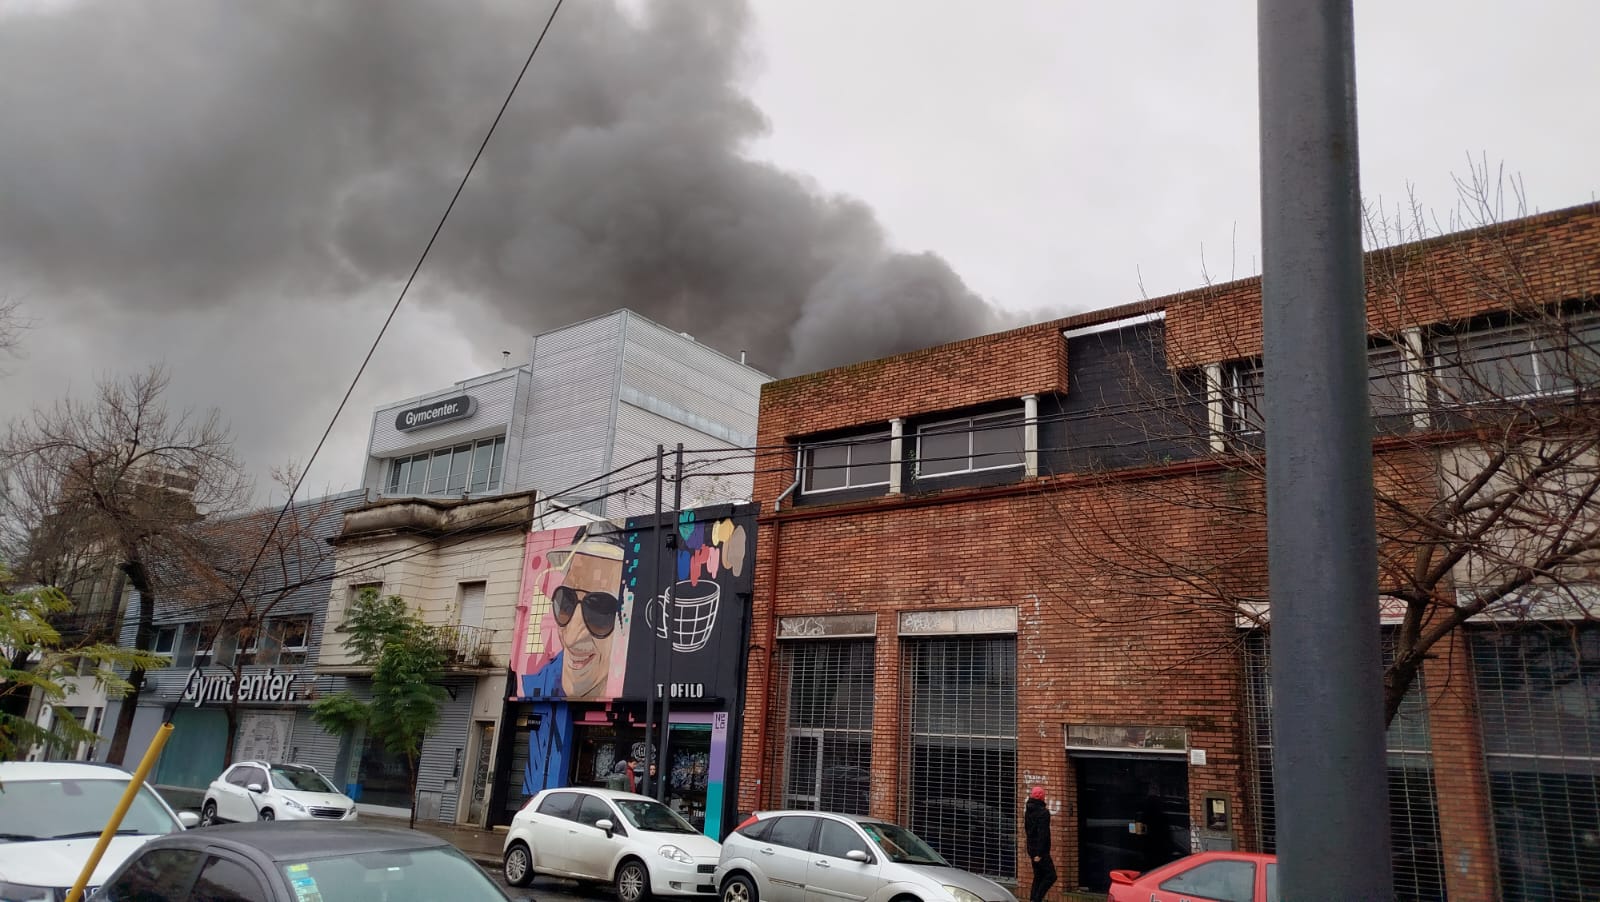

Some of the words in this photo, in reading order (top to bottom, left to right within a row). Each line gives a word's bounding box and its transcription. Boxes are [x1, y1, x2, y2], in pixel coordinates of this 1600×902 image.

[405, 403, 459, 426] Gymcenter.
[184, 667, 296, 708] Gymcenter.
[657, 683, 703, 698] TOFILO
